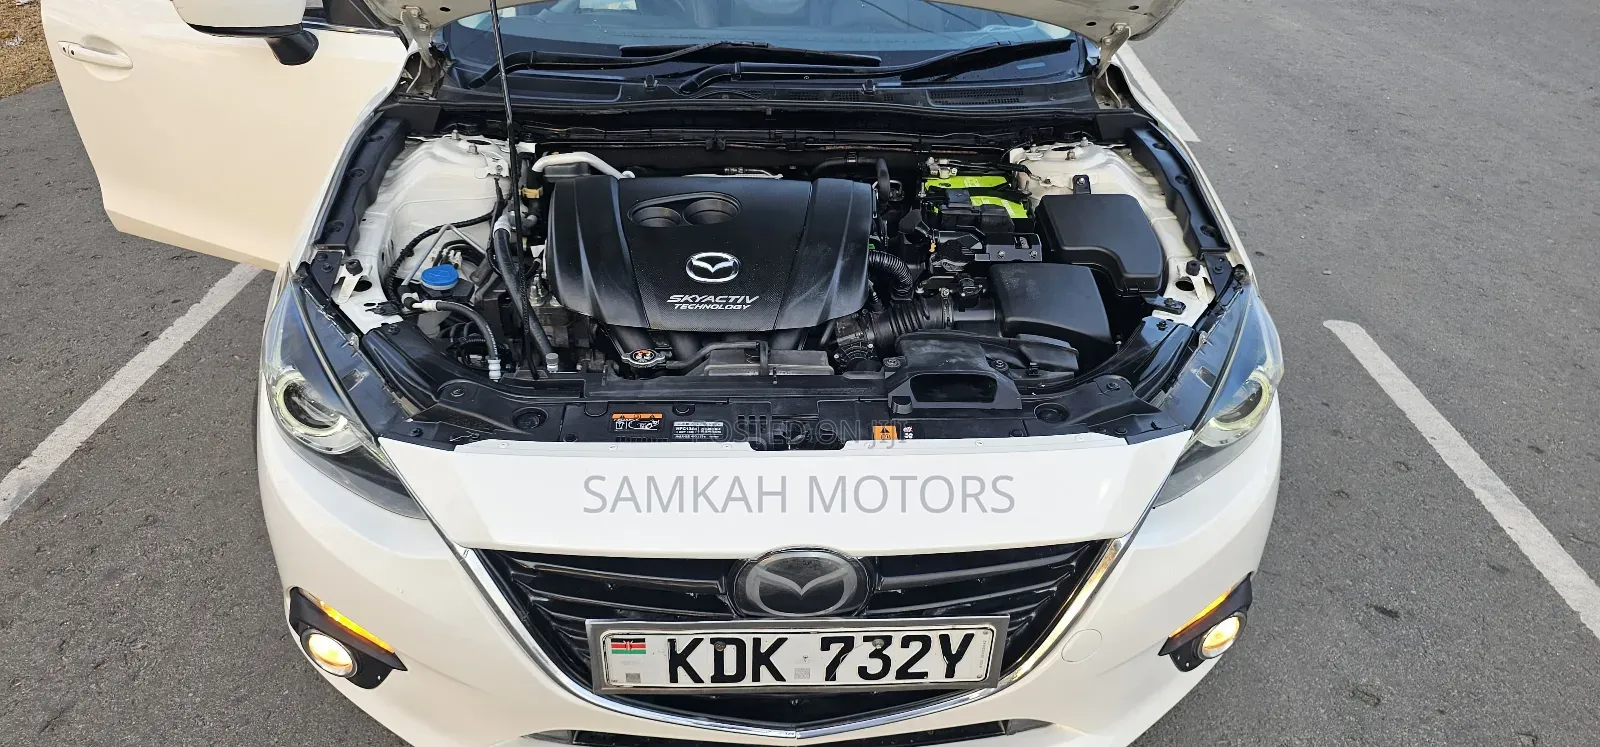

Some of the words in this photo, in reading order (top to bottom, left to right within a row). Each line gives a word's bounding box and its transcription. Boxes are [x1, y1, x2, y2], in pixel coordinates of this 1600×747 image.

[667, 294, 760, 304] SKYACTIV
[667, 636, 789, 684] KDK
[819, 633, 975, 682] 732Y
